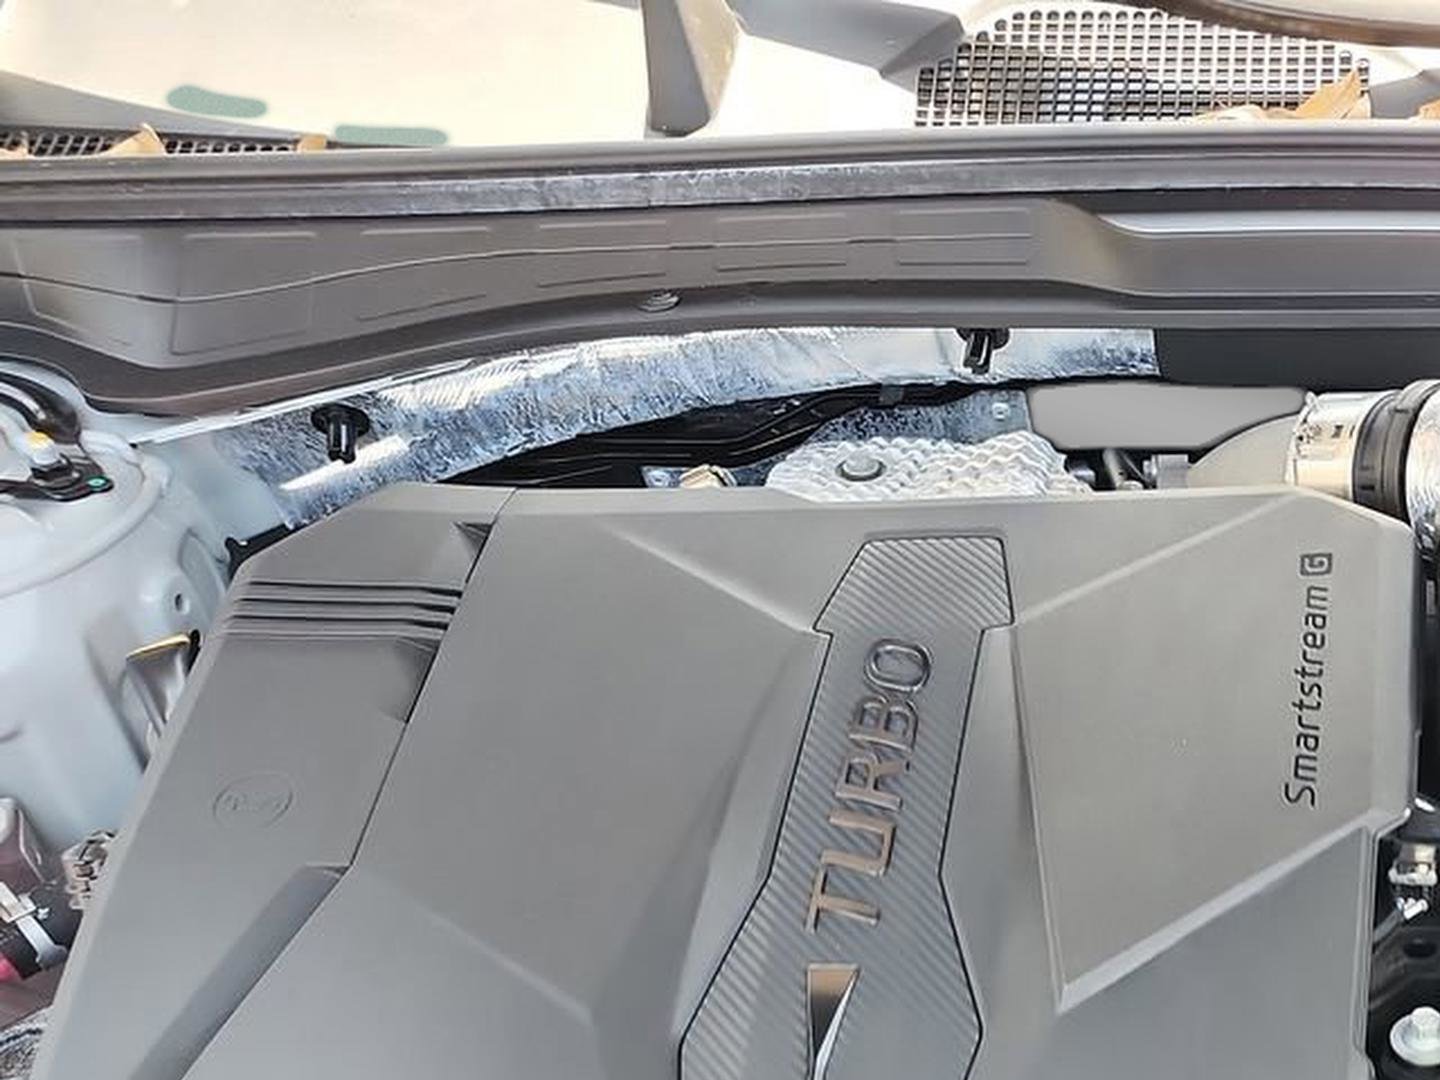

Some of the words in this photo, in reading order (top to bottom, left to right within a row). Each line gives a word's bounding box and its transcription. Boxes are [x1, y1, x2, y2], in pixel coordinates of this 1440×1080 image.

[1300, 552, 1333, 577] G
[803, 637, 931, 934] TURBO
[1284, 585, 1329, 807] Smartstream
